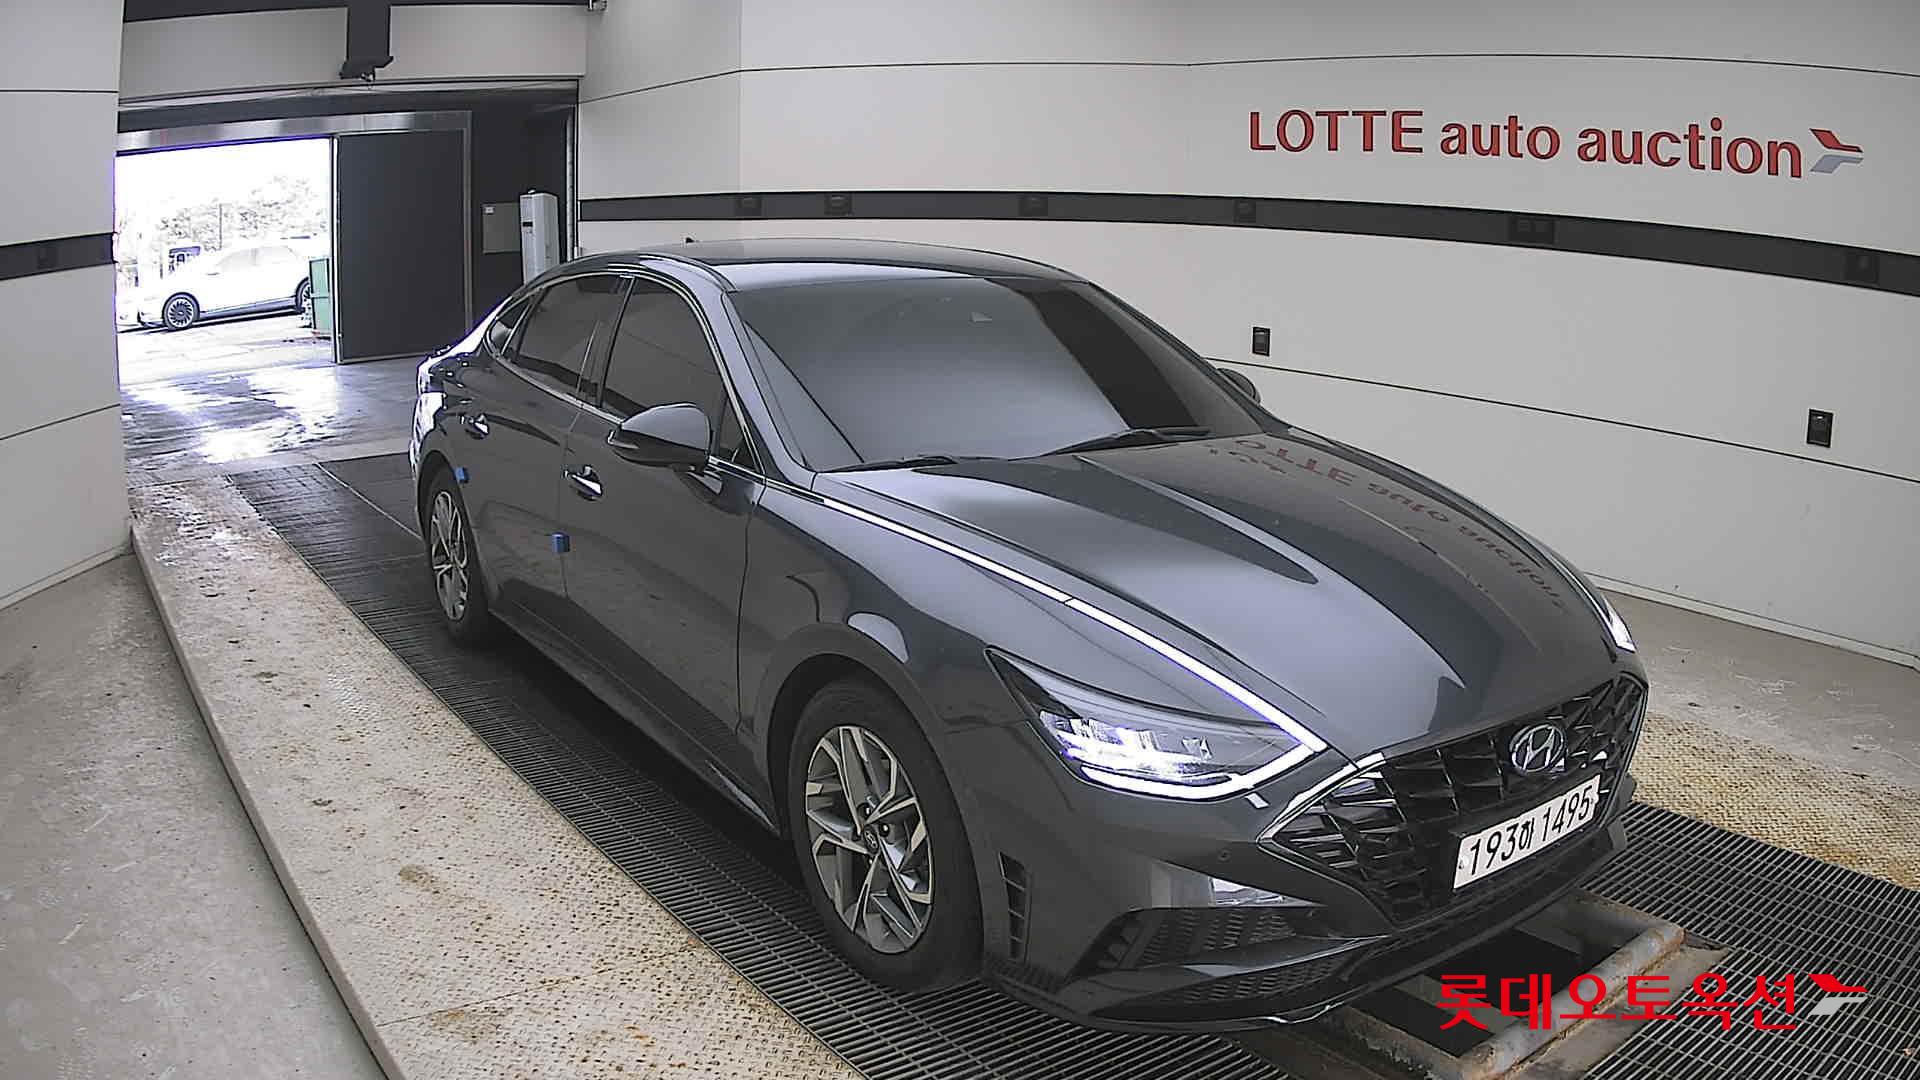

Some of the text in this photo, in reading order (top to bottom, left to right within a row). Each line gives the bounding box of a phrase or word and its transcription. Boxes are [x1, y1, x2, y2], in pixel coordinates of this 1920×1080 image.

[1249, 109, 1803, 179] LOTTE auto auction
[1542, 785, 1594, 842] 1495
